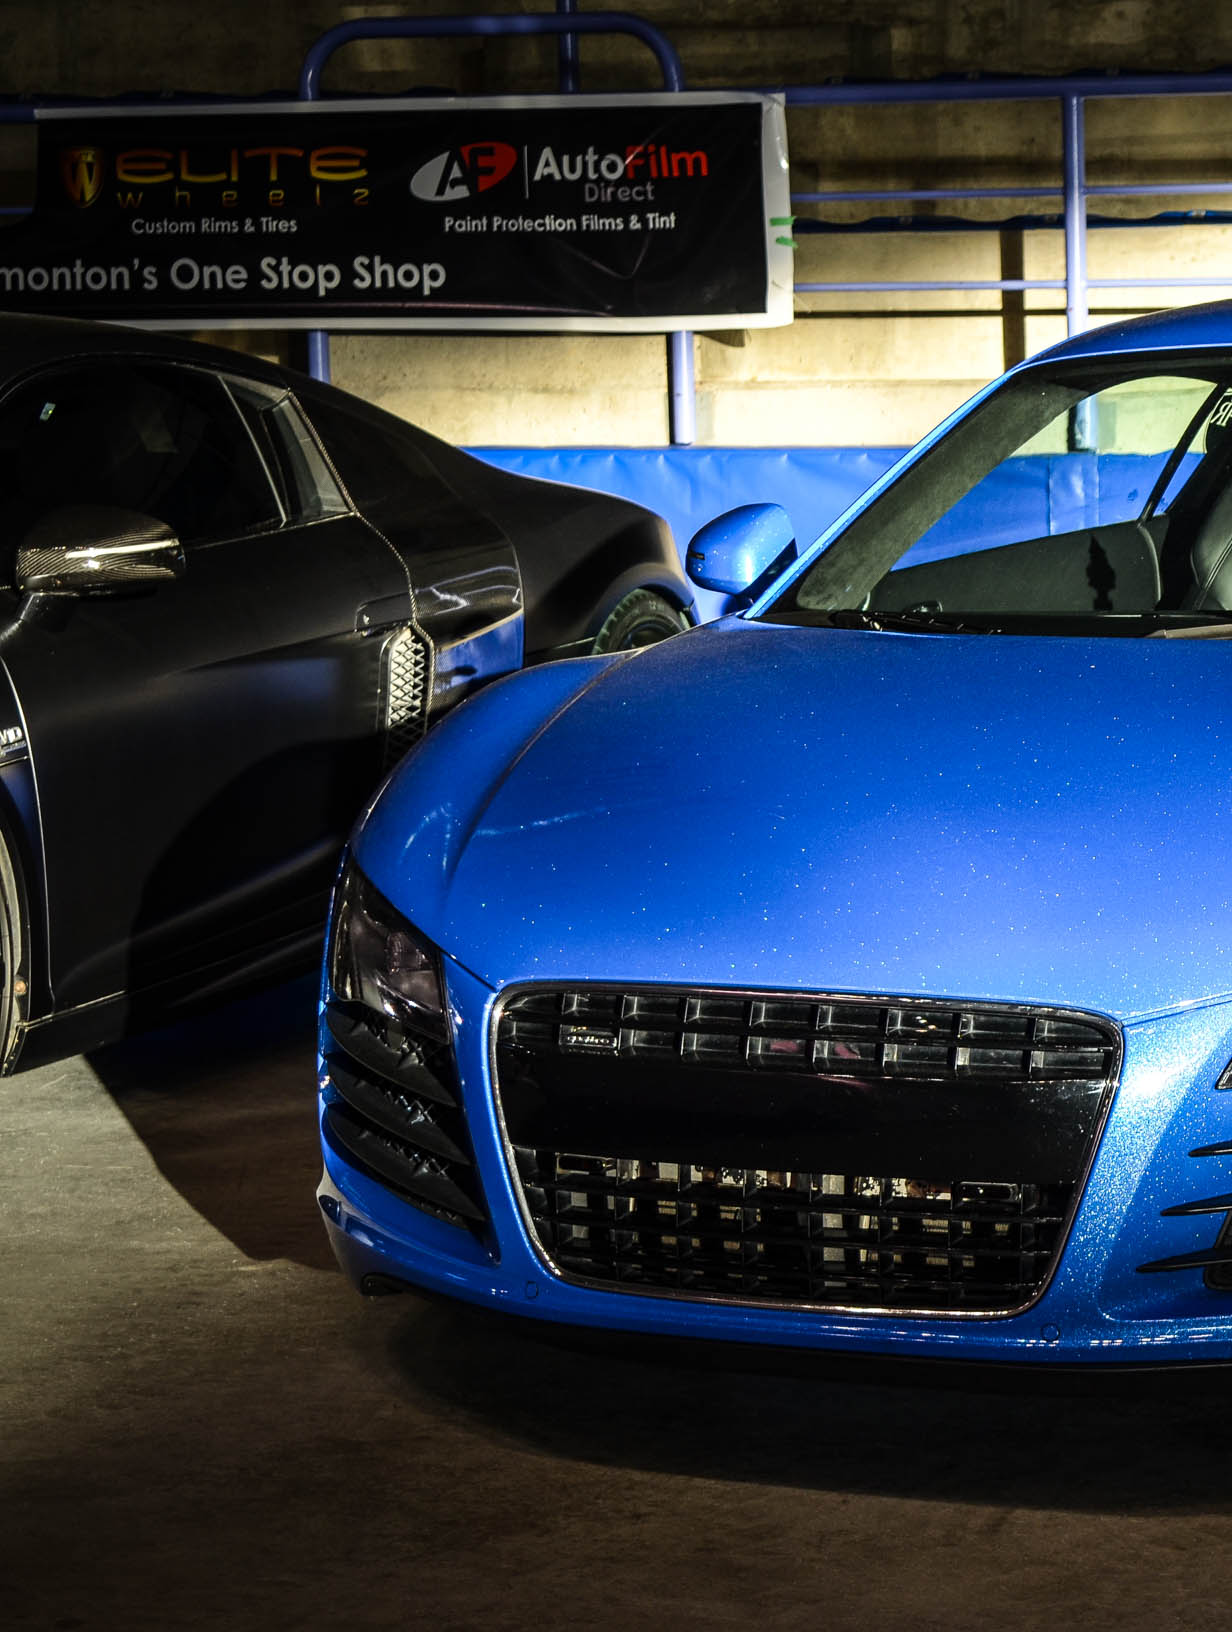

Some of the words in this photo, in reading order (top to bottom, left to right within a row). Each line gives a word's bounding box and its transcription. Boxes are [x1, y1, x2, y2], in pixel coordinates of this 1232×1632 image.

[115, 146, 368, 183] ELITE
[533, 145, 709, 181] AutoFilm
[584, 181, 655, 203] Direct
[131, 218, 196, 235] Custom
[201, 217, 239, 233] Rims
[244, 217, 256, 233] &
[260, 216, 298, 233] Tires
[444, 215, 488, 233] Paint
[492, 214, 577, 232] Protection
[581, 214, 625, 231] Films
[629, 214, 642, 230] &
[646, 212, 677, 230] Tint
[170, 257, 249, 290] One
[260, 256, 341, 297] Stop
[352, 255, 447, 296] Shop
